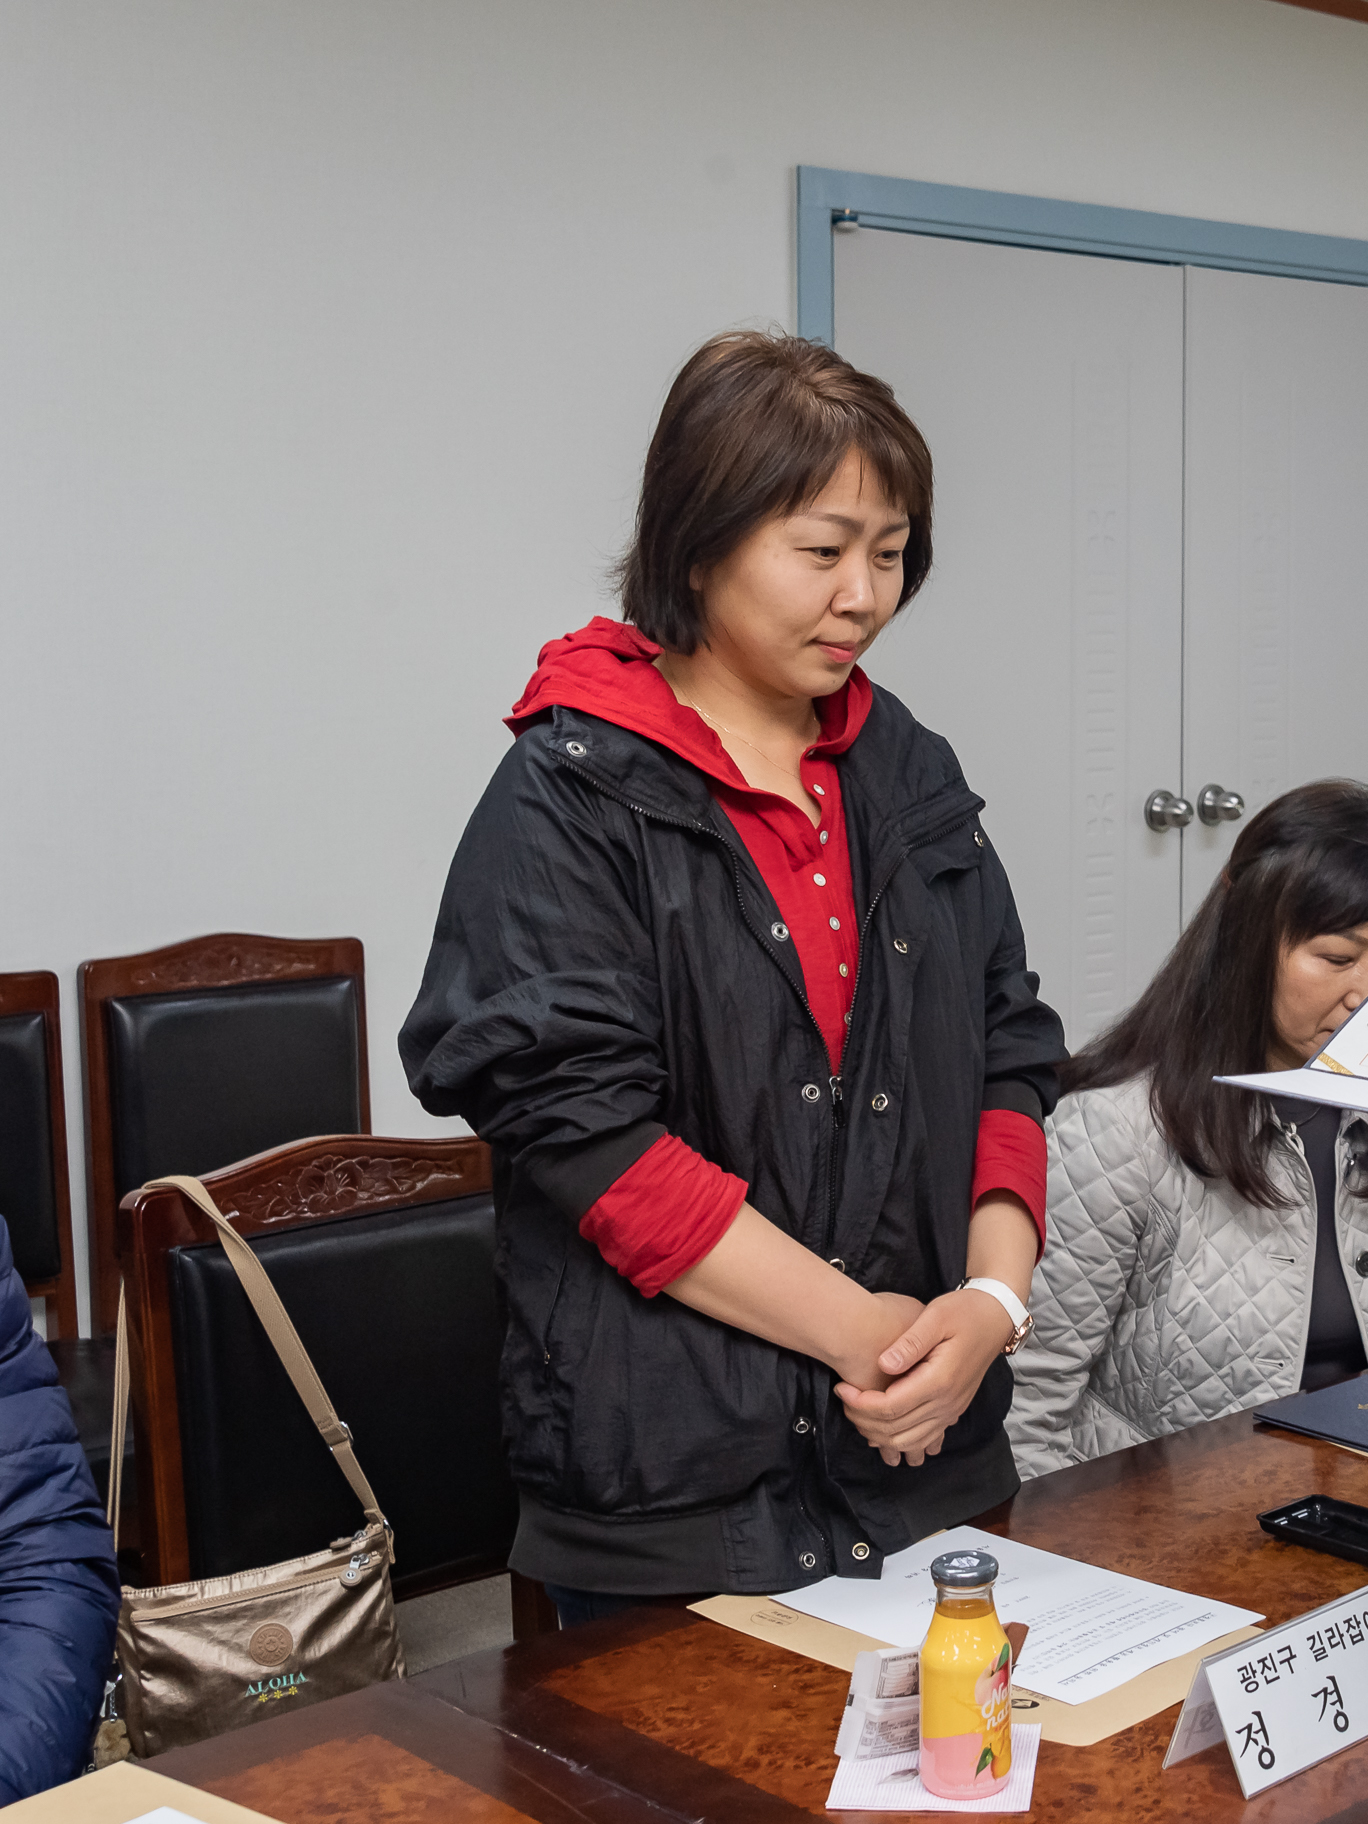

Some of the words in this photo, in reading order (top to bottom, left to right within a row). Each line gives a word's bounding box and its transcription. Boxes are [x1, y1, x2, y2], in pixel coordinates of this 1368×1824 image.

[244, 1671, 309, 1698] ALOHA
[1236, 1645, 1298, 1694] 광진구
[1235, 1710, 1276, 1770] 정
[1311, 1675, 1350, 1733] 경
